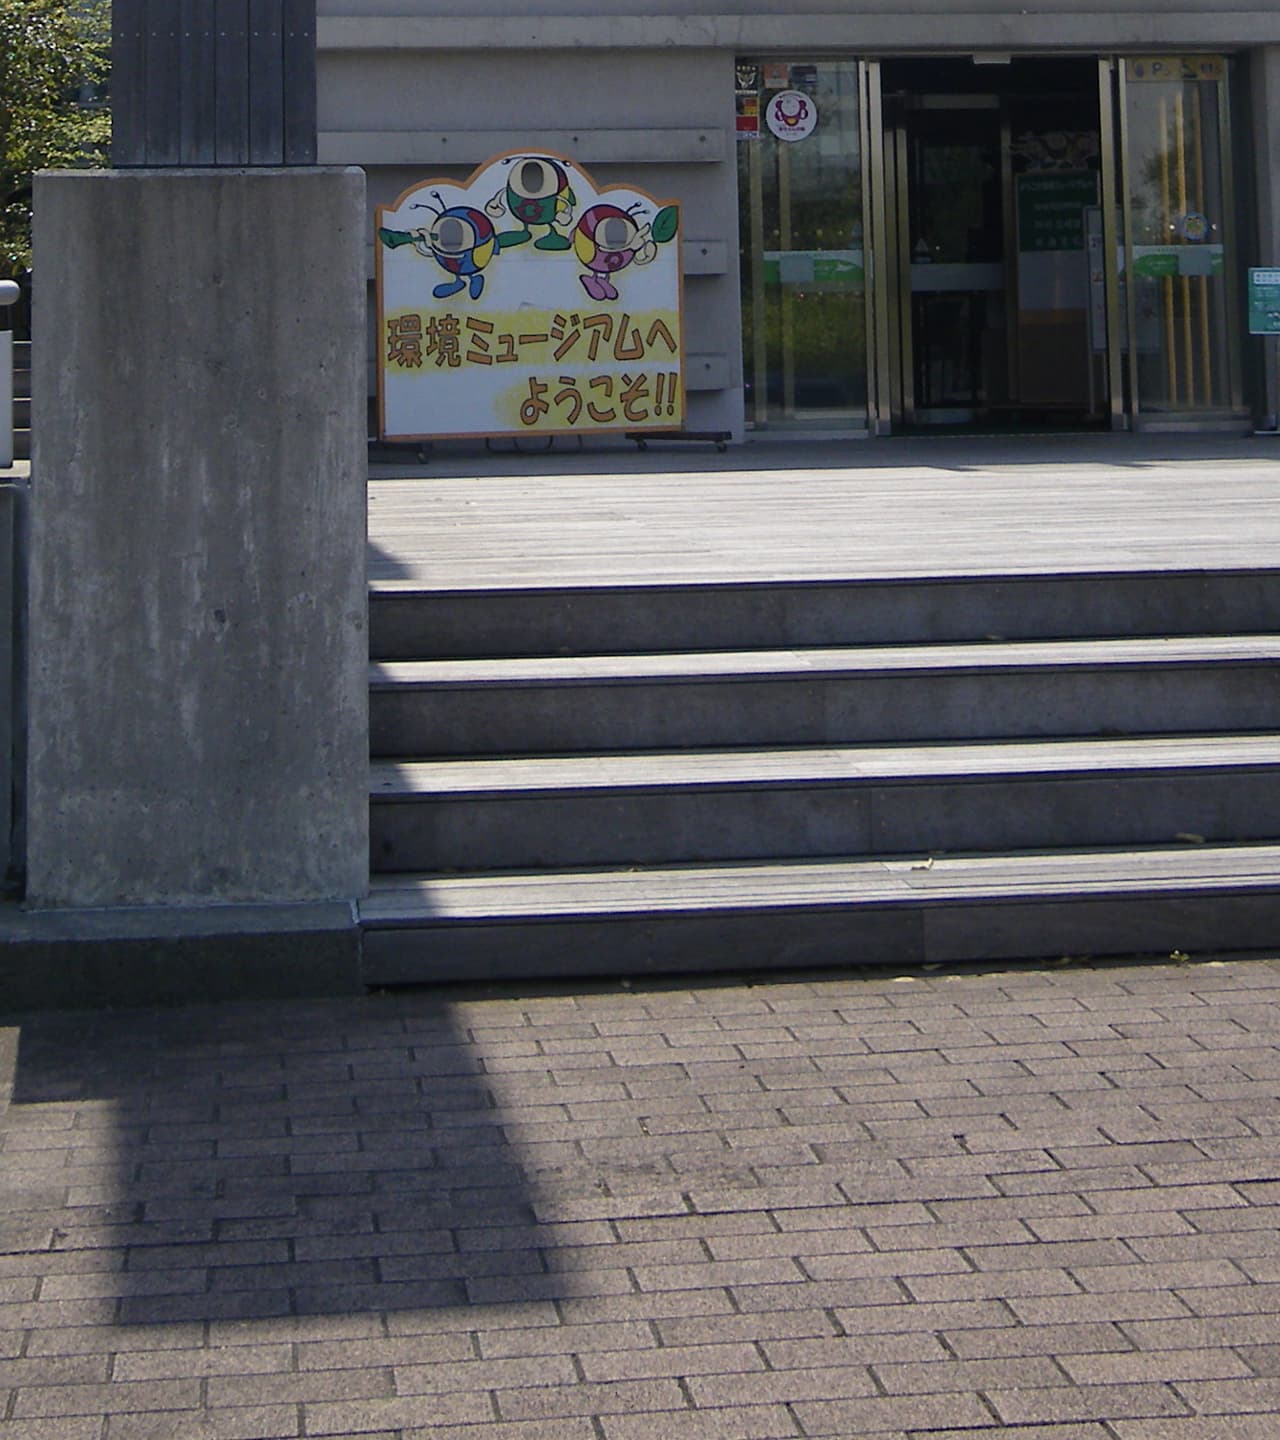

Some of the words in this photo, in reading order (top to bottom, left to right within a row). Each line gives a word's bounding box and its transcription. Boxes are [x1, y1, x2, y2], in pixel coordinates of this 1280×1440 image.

[387, 313, 678, 368] 環境ミュージアムへ
